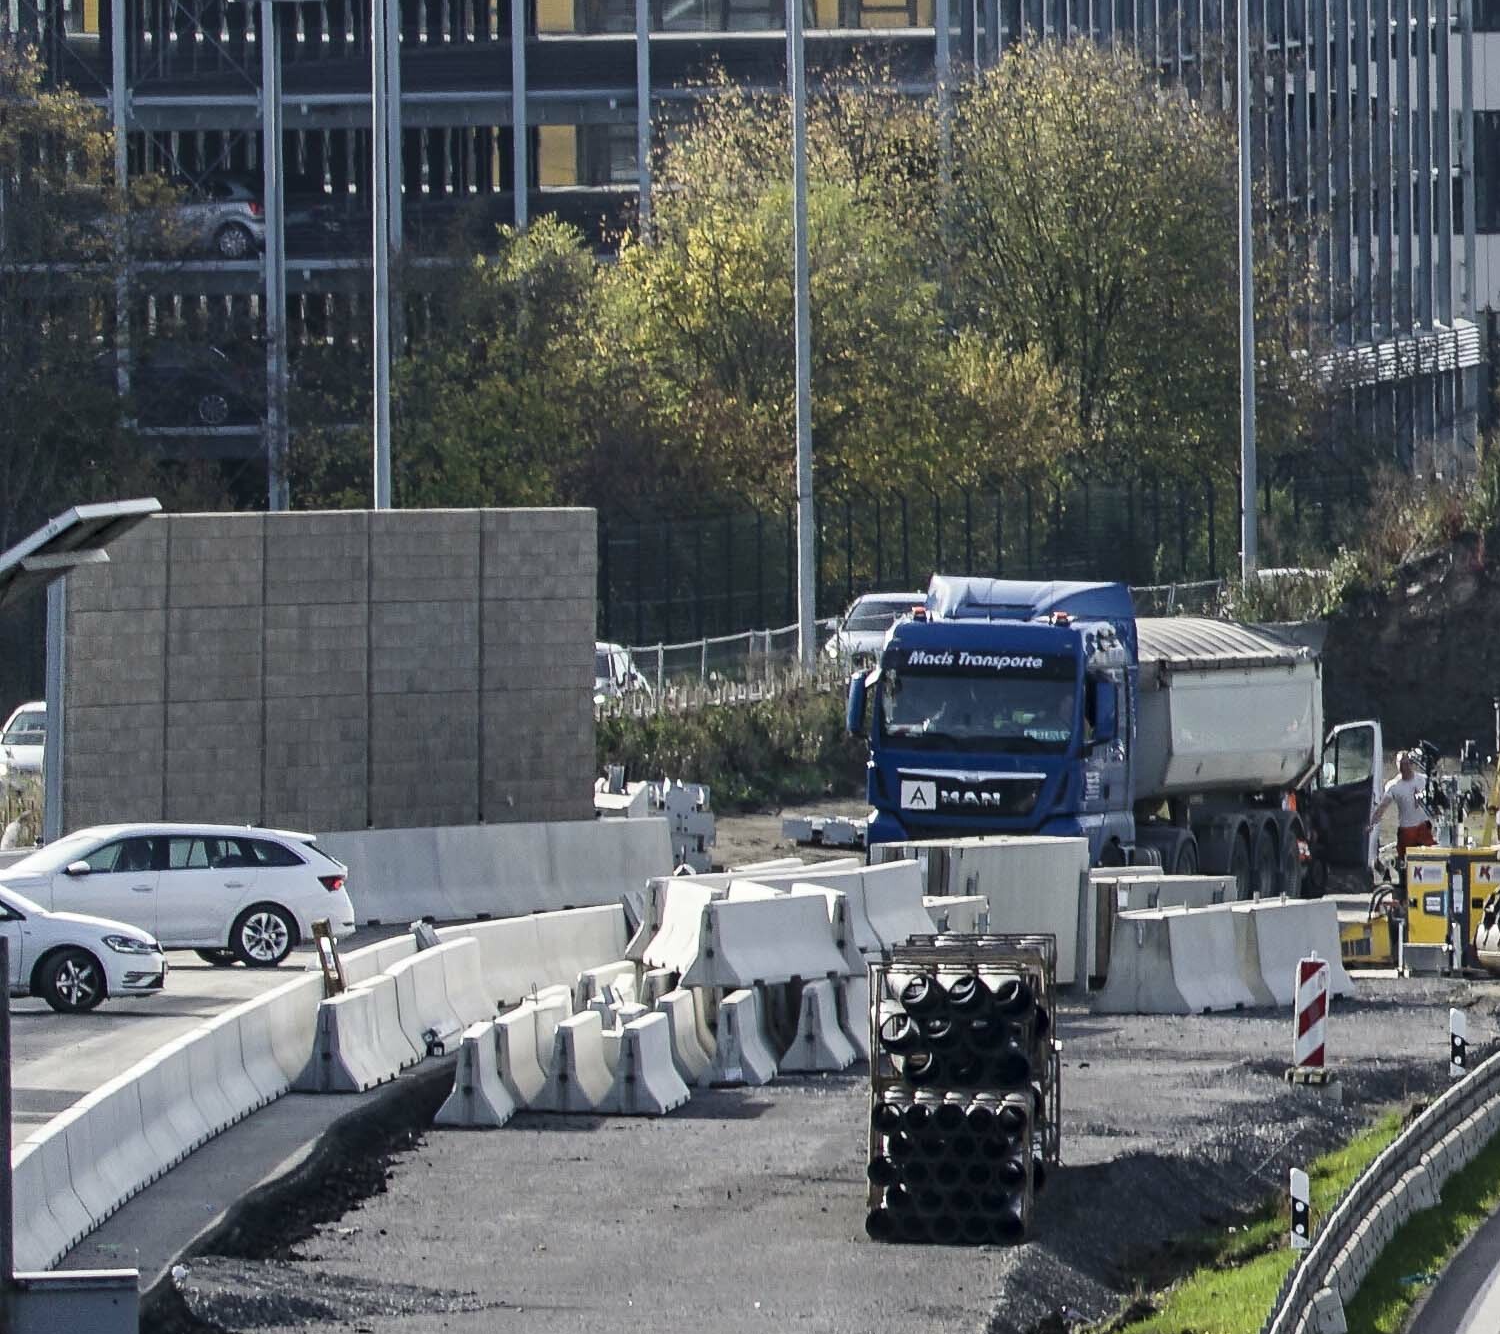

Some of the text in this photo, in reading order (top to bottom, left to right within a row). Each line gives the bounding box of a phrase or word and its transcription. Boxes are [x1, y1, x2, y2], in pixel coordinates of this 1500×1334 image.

[957, 651, 1044, 670] Transporte
[909, 785, 927, 805] A
[940, 790, 1001, 807] MAN
